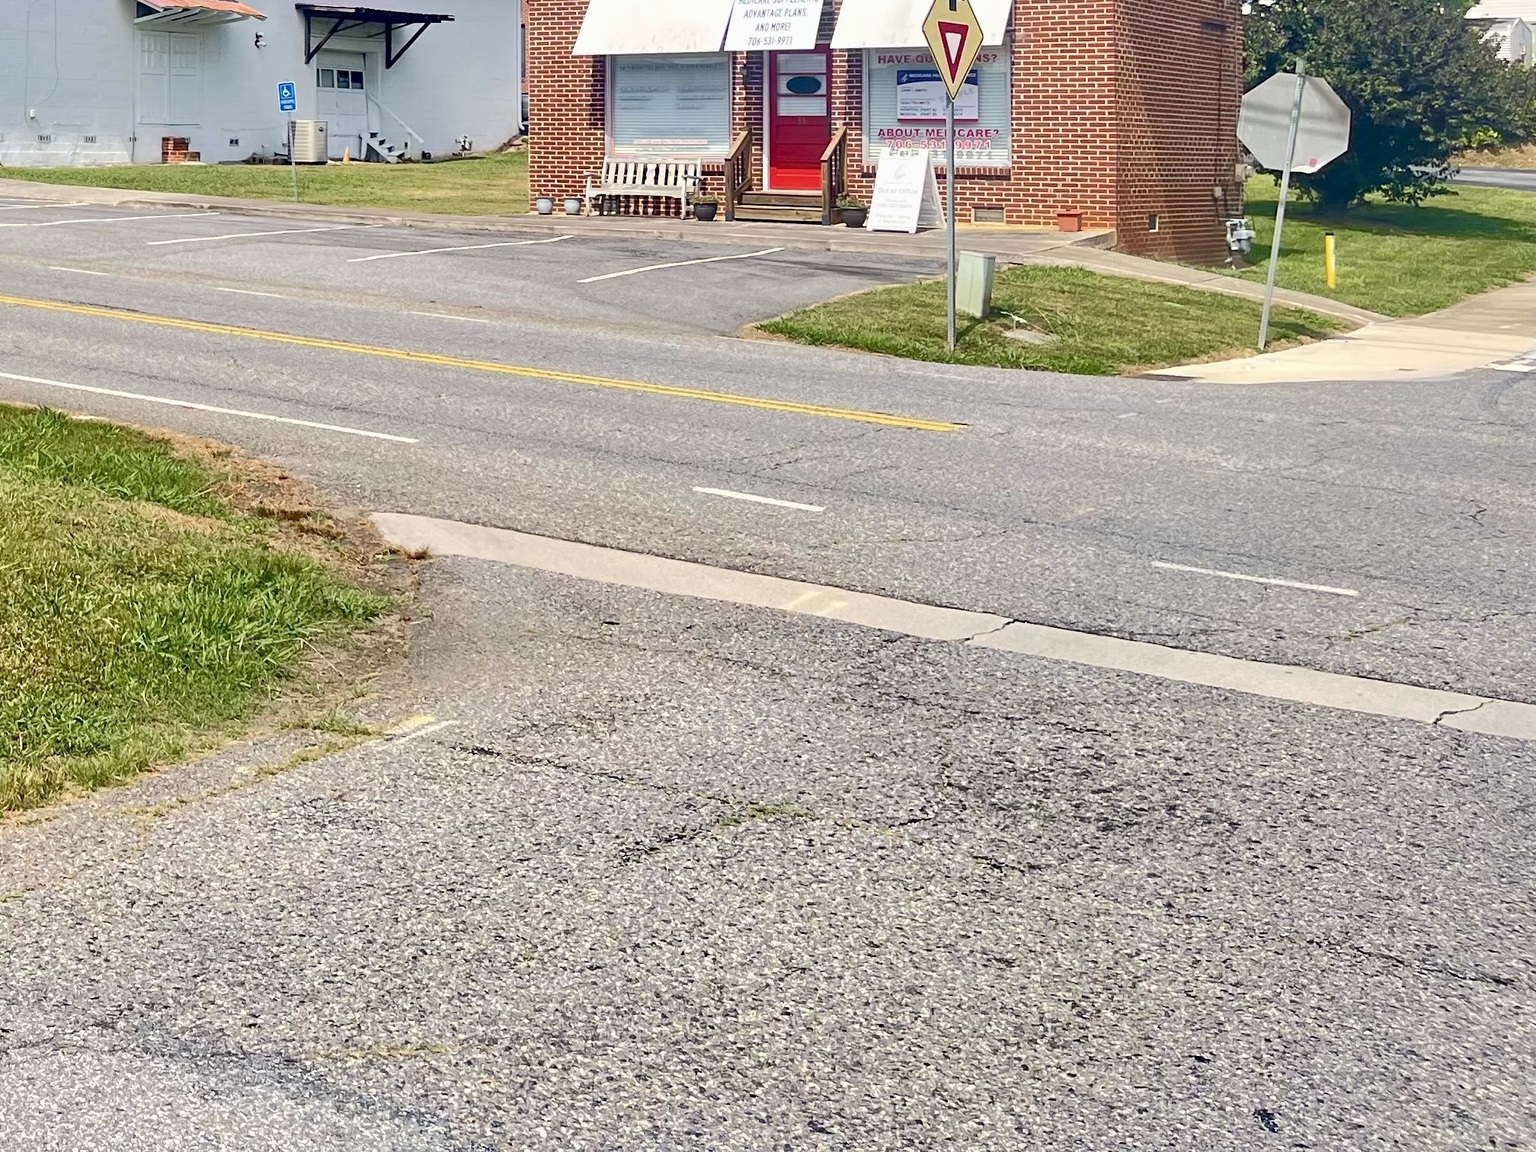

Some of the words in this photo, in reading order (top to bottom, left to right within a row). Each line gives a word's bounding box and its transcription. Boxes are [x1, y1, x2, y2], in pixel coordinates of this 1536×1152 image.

[743, 8, 783, 18] ADVANTAGE
[755, 23, 770, 32] AND
[747, 36, 794, 46] 706-531-9971
[877, 54, 912, 64] HAVE
[915, 53, 998, 64] QUNS?
[877, 128, 921, 137] ABOUT
[925, 128, 1000, 138] MEICARE?
[885, 139, 992, 150] 706-5319971
